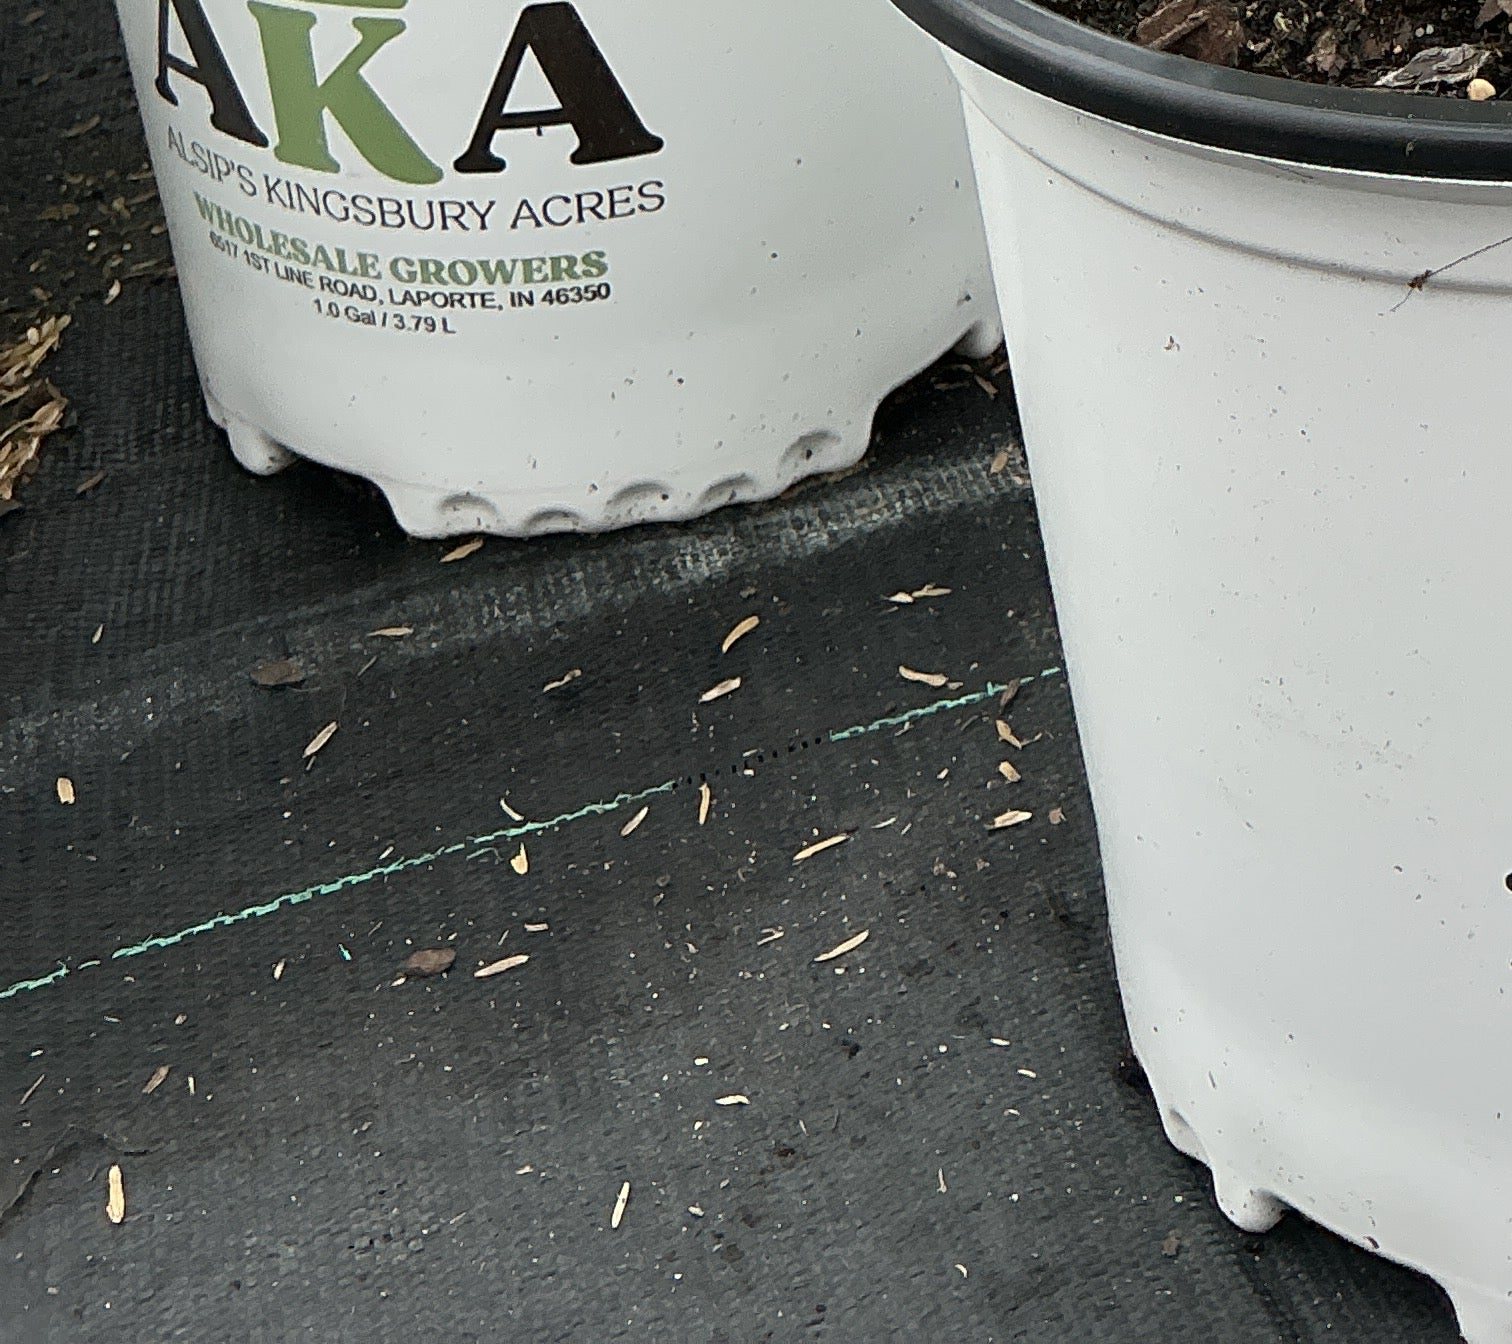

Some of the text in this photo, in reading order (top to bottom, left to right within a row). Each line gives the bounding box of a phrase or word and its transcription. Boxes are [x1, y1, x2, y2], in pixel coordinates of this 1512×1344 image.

[168, 125, 665, 231] ALSIP'S KINGSBURY ACRES
[194, 190, 609, 286] WHOLESALE GROWERS
[243, 249, 270, 274] 1ST
[274, 262, 315, 289] LINE
[510, 290, 534, 308] IN
[541, 282, 612, 306] 46350
[313, 298, 340, 318] 1.0
[344, 305, 377, 327] Gal
[393, 315, 437, 333] 3.79
[442, 319, 456, 334] L
